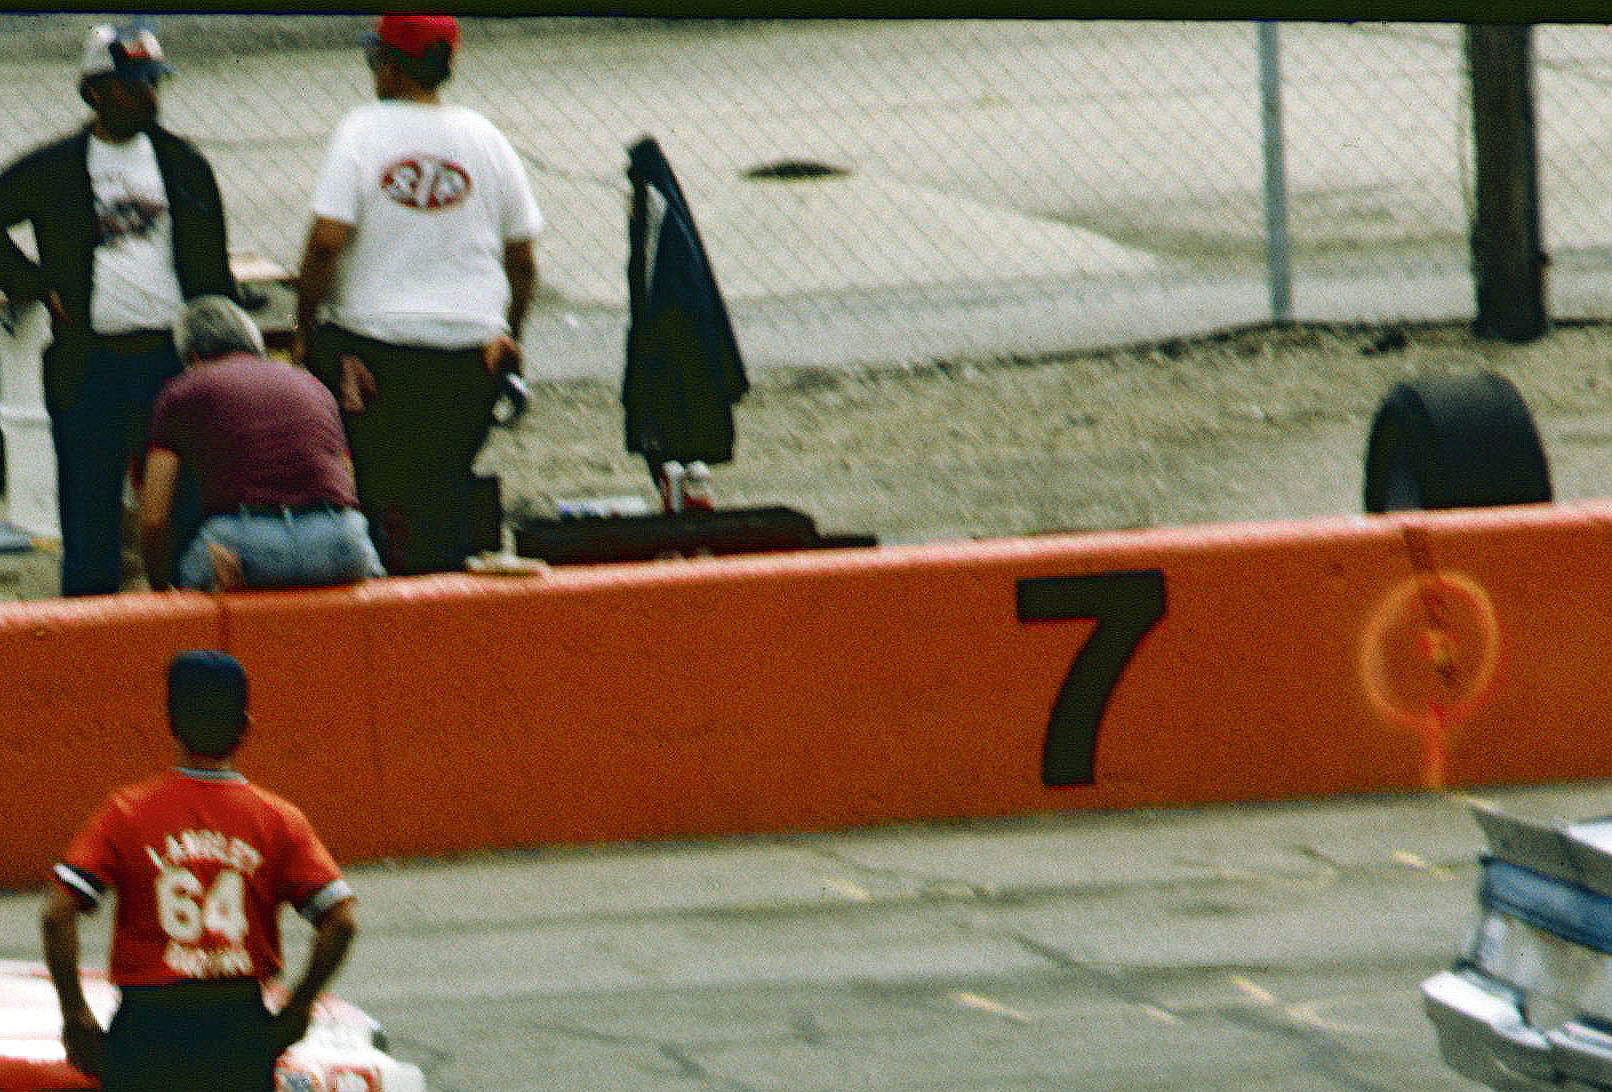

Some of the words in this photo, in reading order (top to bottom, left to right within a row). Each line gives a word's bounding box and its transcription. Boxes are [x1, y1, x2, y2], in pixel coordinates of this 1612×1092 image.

[382, 158, 471, 212] STP
[1016, 569, 1167, 787] 7
[155, 866, 250, 944] 64
